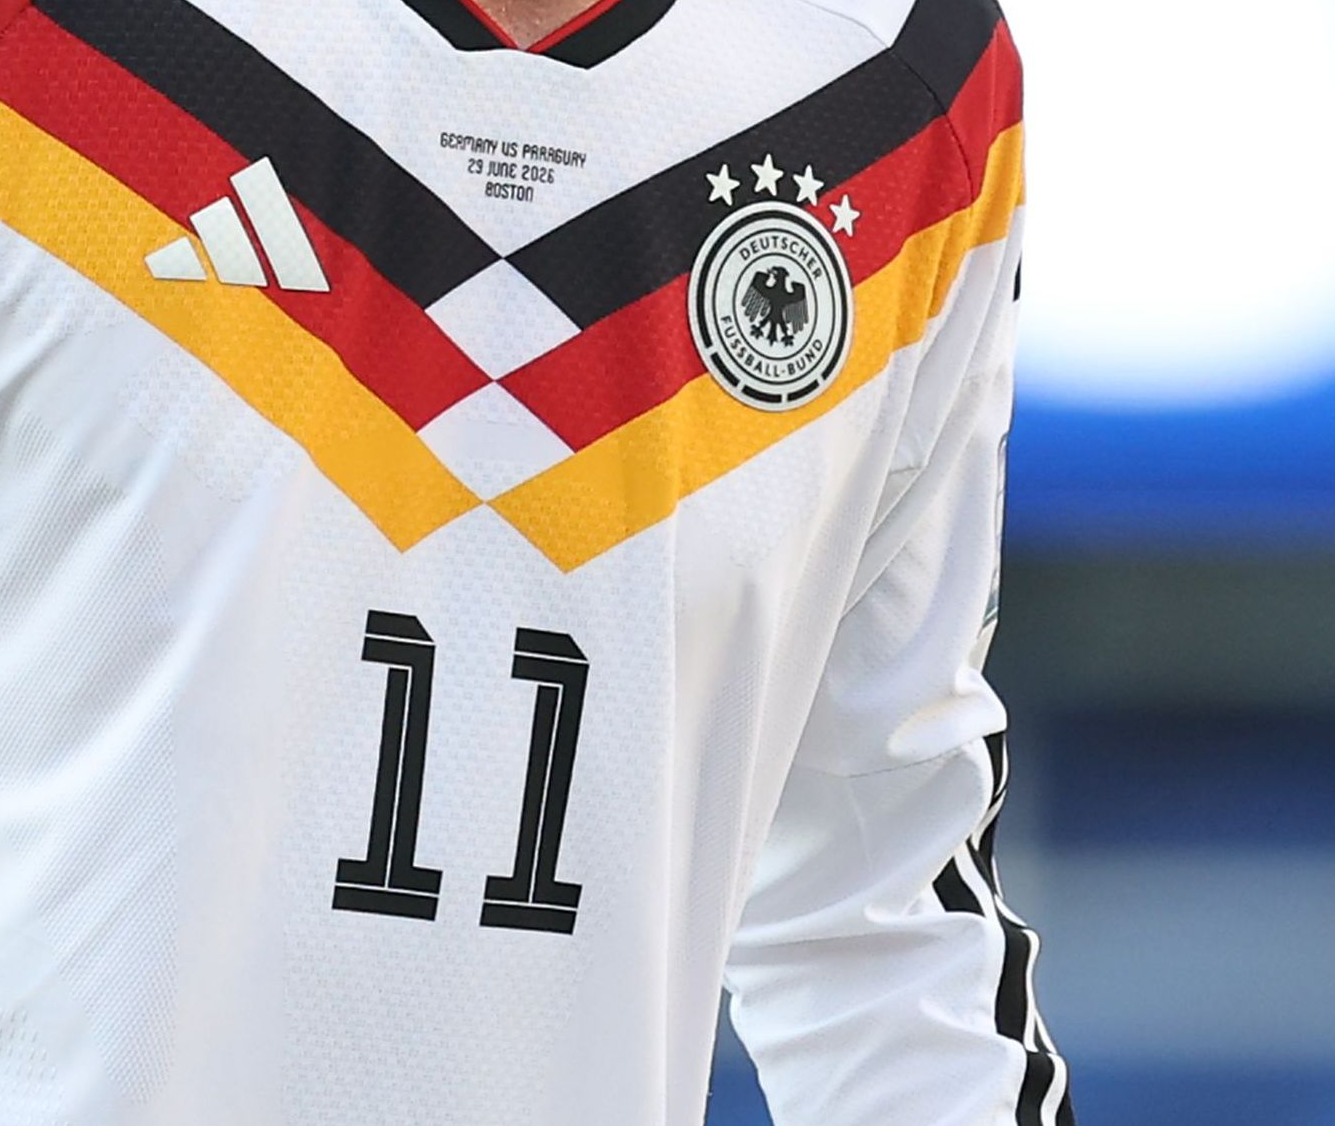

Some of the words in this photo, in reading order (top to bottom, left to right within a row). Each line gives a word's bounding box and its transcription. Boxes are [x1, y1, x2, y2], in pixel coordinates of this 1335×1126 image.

[440, 132, 498, 154] GERMANY
[522, 144, 587, 168] PARAGUAY
[467, 158, 483, 174] 29
[487, 161, 517, 179] JUNE
[521, 164, 554, 184] 2026
[485, 181, 534, 202] BOSTON
[739, 236, 822, 280] DEUTSCHER
[721, 315, 823, 378] FUSSBALL-BUND
[332, 609, 590, 936] 11
